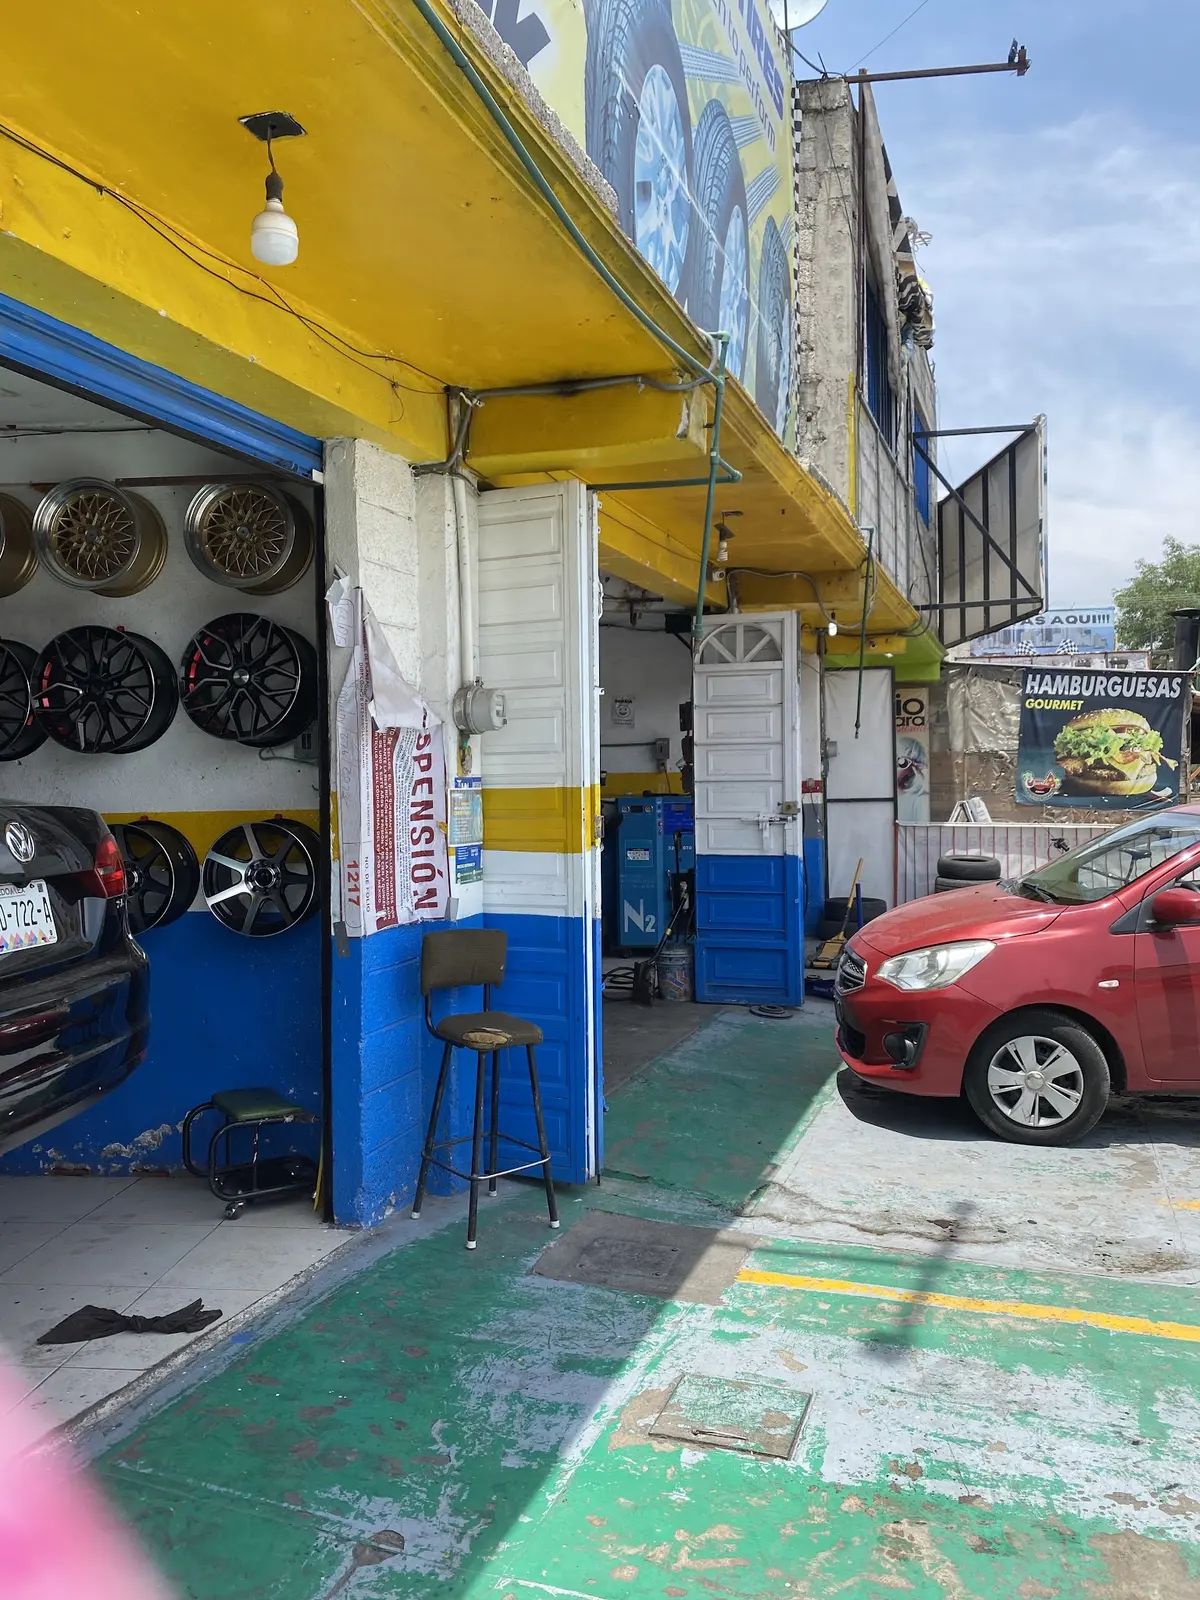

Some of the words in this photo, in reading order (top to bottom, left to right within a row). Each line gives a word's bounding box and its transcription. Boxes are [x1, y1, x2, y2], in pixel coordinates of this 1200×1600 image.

[738, 48, 776, 152] perform
[1020, 615, 1046, 626] AS
[1051, 614, 1110, 625] AQUI!!!
[1025, 673, 1183, 698] HAMBURGUESAS
[895, 693, 925, 716] io
[1025, 698, 1085, 711] GOURMET
[895, 716, 925, 727] ara
[410, 731, 443, 911] SPENSIÓN
[347, 861, 360, 907] 1217
[624, 898, 656, 933] N2
